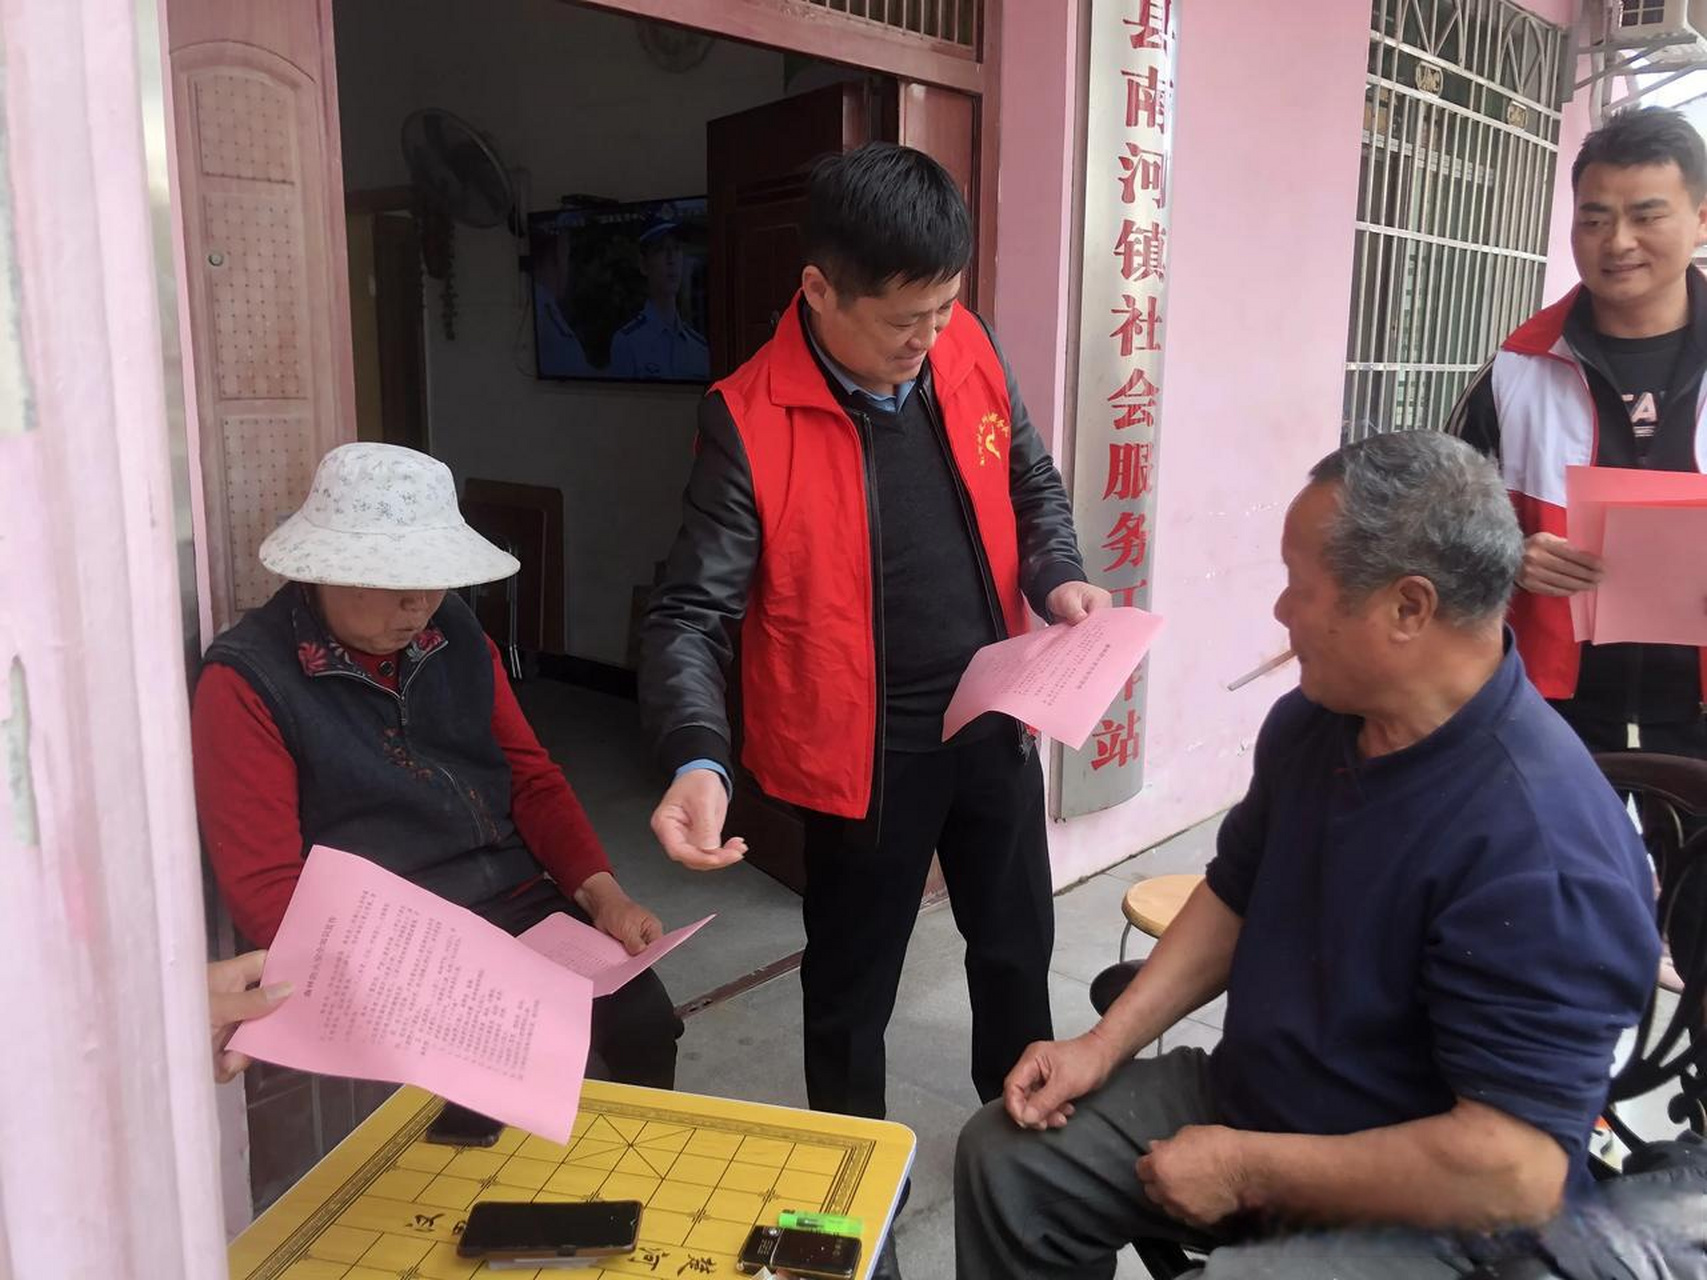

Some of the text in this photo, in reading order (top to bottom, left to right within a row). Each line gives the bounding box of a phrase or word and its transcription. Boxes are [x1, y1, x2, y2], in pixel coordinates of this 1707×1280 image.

[1088, 0, 1176, 771] 县南河镇社会服务站
